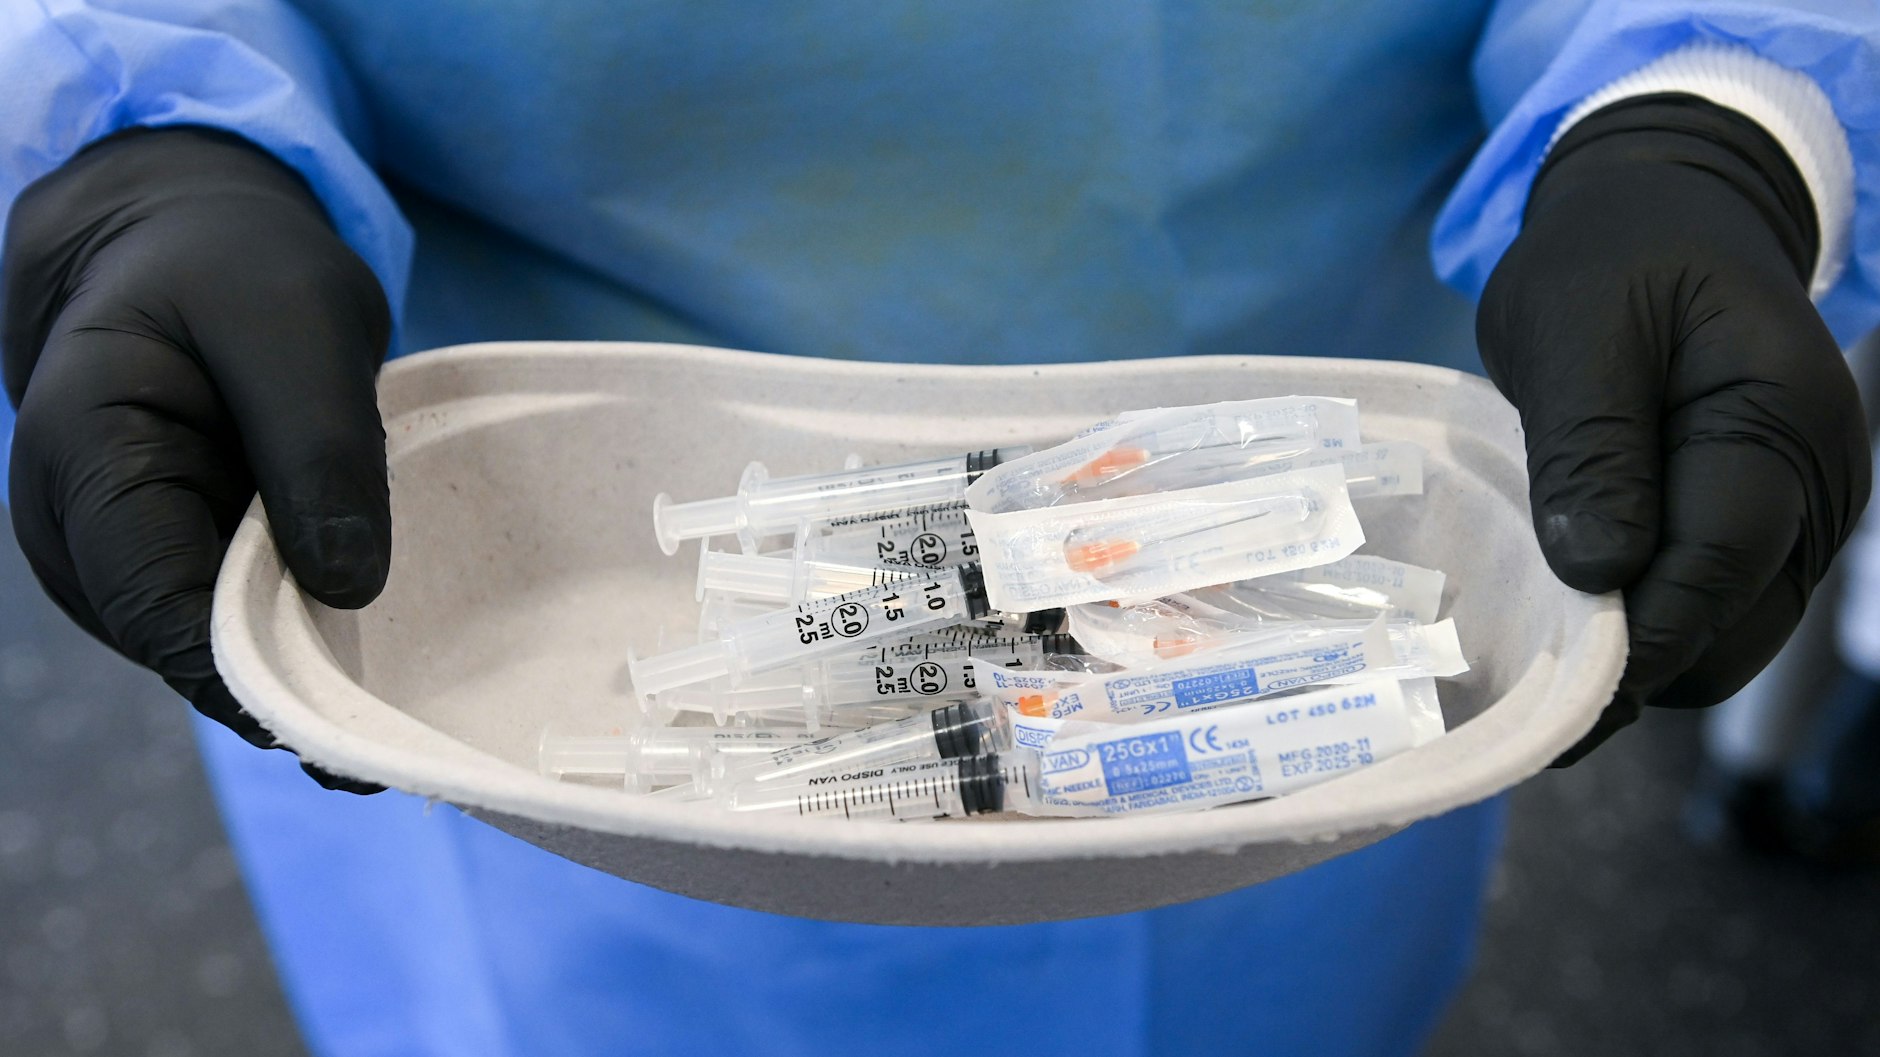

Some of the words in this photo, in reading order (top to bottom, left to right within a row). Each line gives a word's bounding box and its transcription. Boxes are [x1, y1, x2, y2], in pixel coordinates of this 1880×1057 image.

[876, 540, 896, 560] 2.
[919, 536, 938, 564] 2.0
[882, 592, 904, 622] 1.5
[923, 582, 946, 611] 1.0
[795, 615, 819, 645] 2.5
[838, 605, 862, 635] 2.0
[819, 622, 834, 640] ml
[875, 666, 895, 695] 2.5
[897, 677, 911, 694] ml
[919, 665, 939, 693] 2.0
[1051, 702, 1084, 719] MFG
[1266, 709, 1300, 725] LOT
[1308, 703, 1337, 717] 450
[891, 764, 917, 774] ONLY
[1049, 754, 1081, 769] VAN
[808, 775, 836, 786] VAN
[841, 768, 884, 782] DISPO
